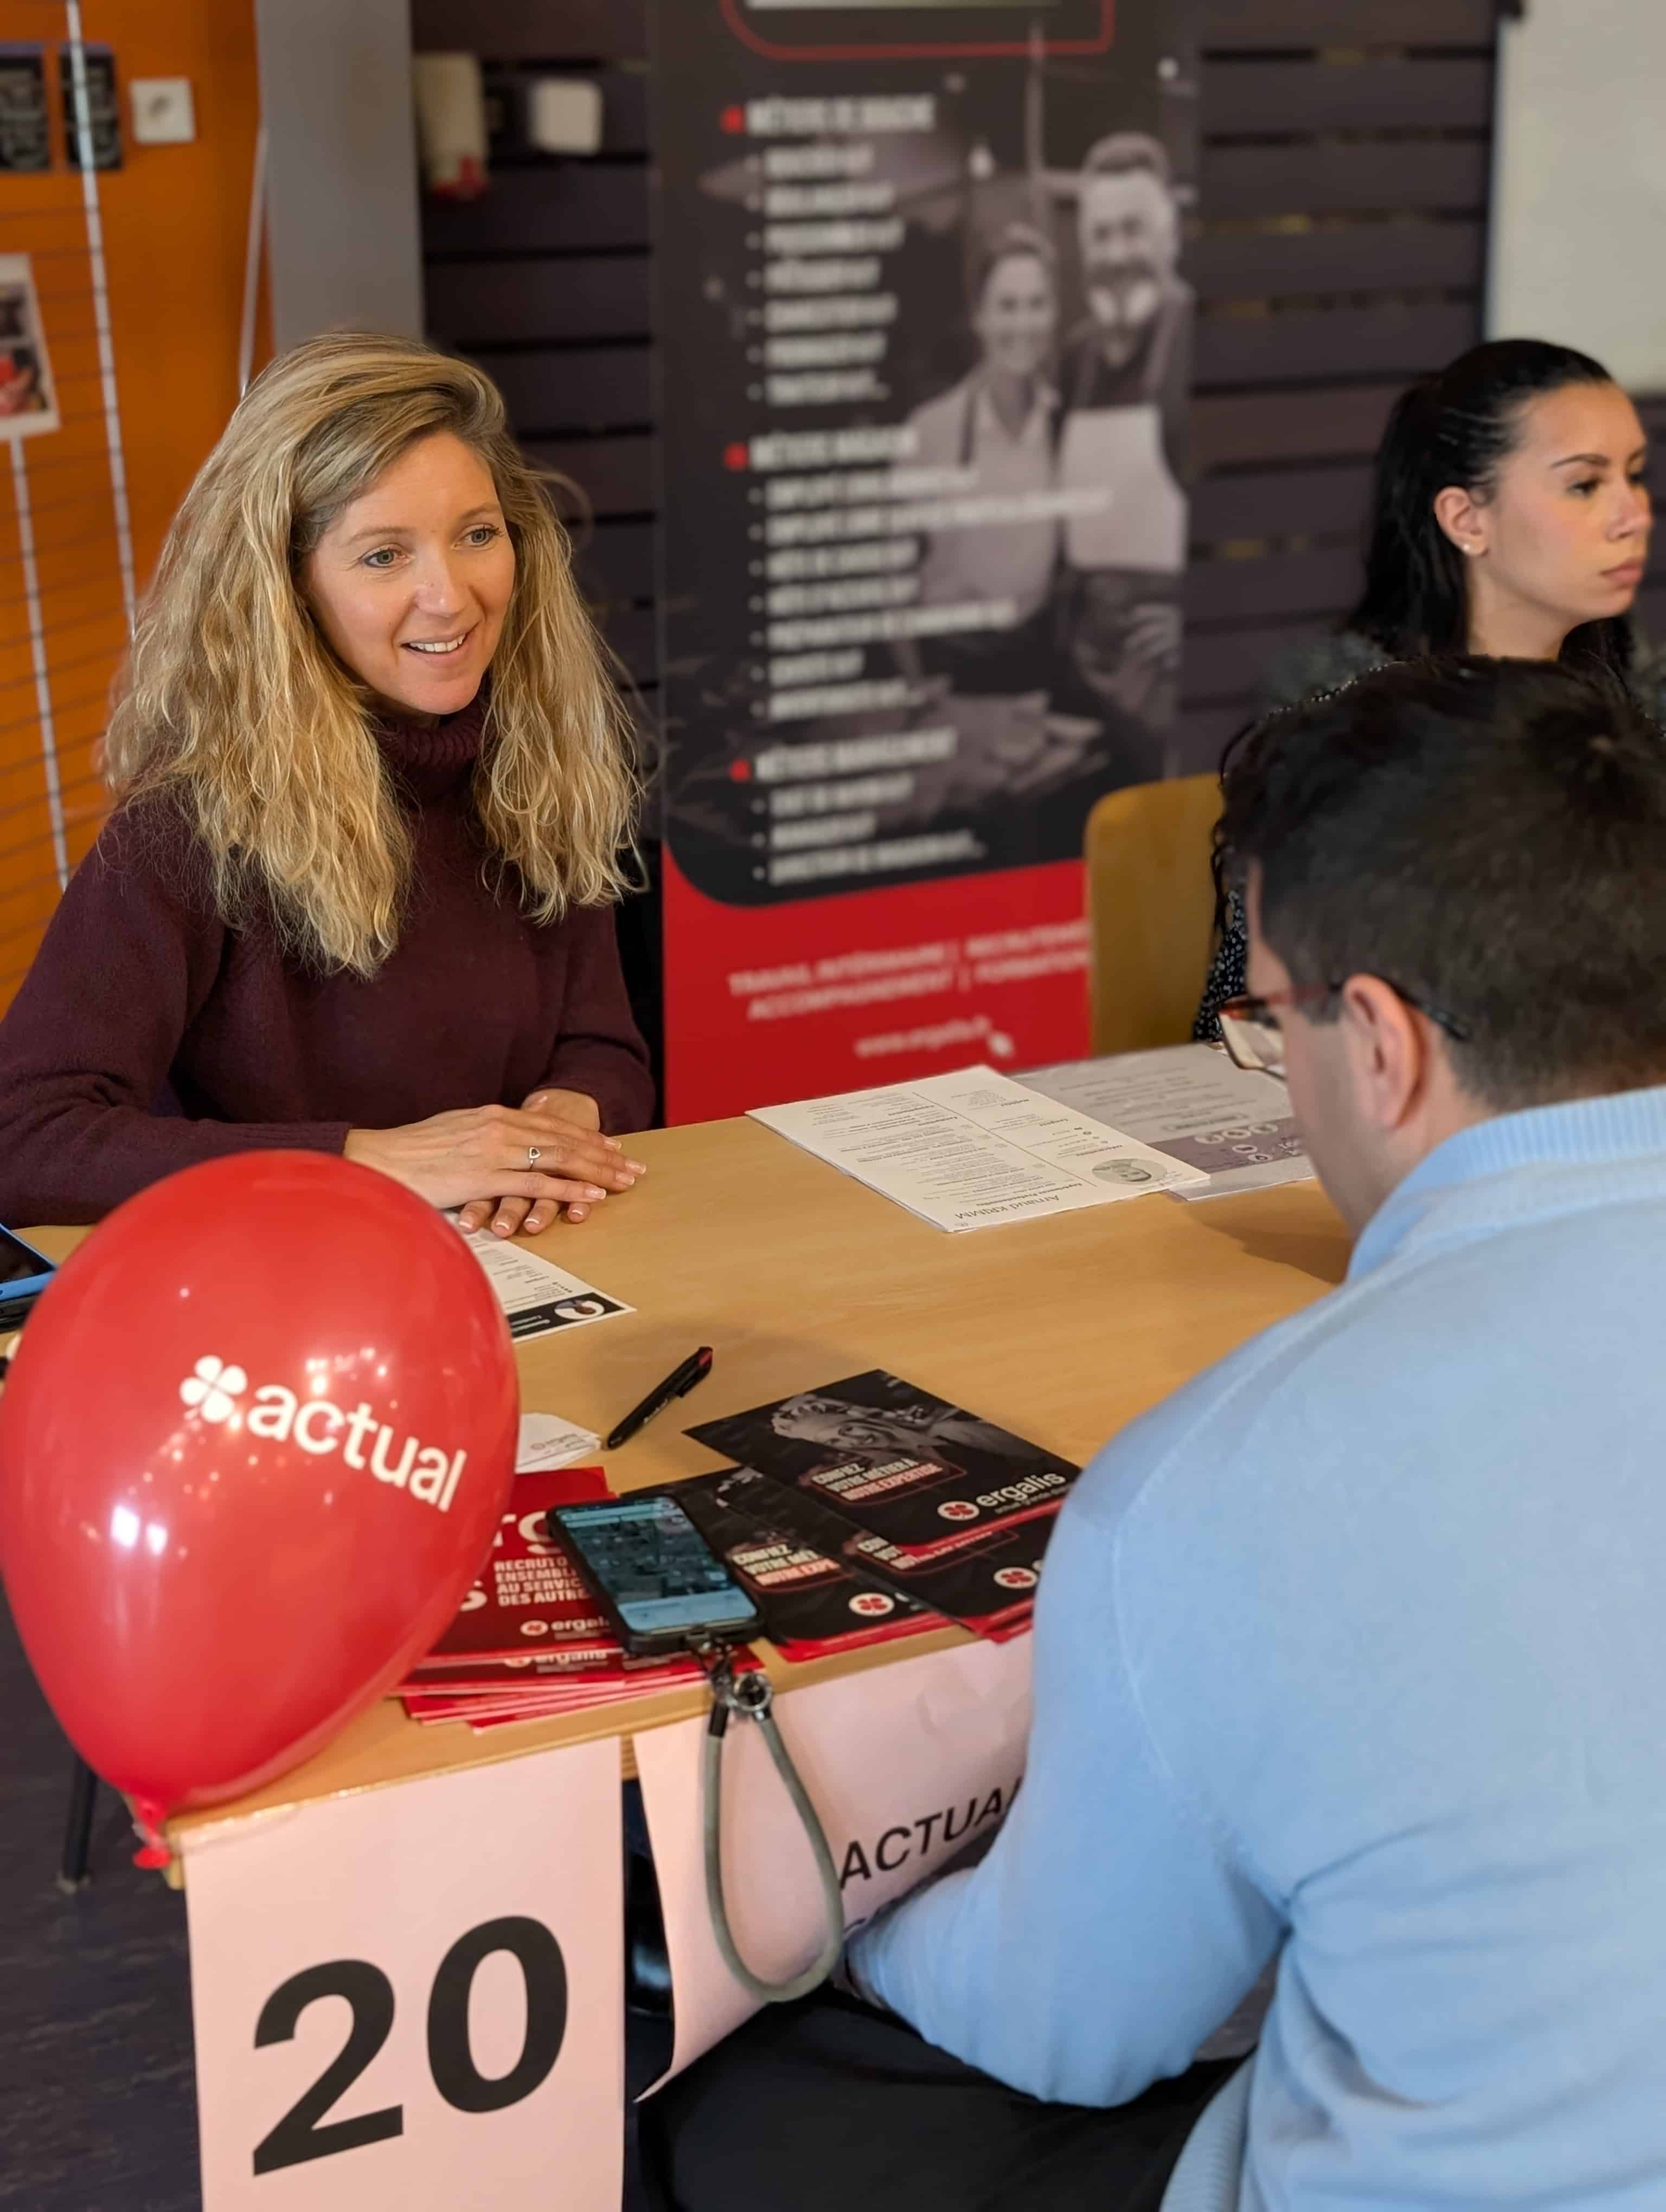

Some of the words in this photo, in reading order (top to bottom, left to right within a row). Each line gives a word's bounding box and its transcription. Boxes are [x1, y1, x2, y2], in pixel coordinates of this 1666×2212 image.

[247, 1384, 467, 1513] actual
[976, 1472, 1067, 1507] ergalis
[494, 1556, 568, 1572] RECRUTO
[497, 1581, 520, 1595] AU
[523, 1577, 581, 1592] SERVIC
[498, 1593, 531, 1607] DES
[534, 1589, 590, 1603] AUTRE
[253, 1915, 568, 2177] 20
